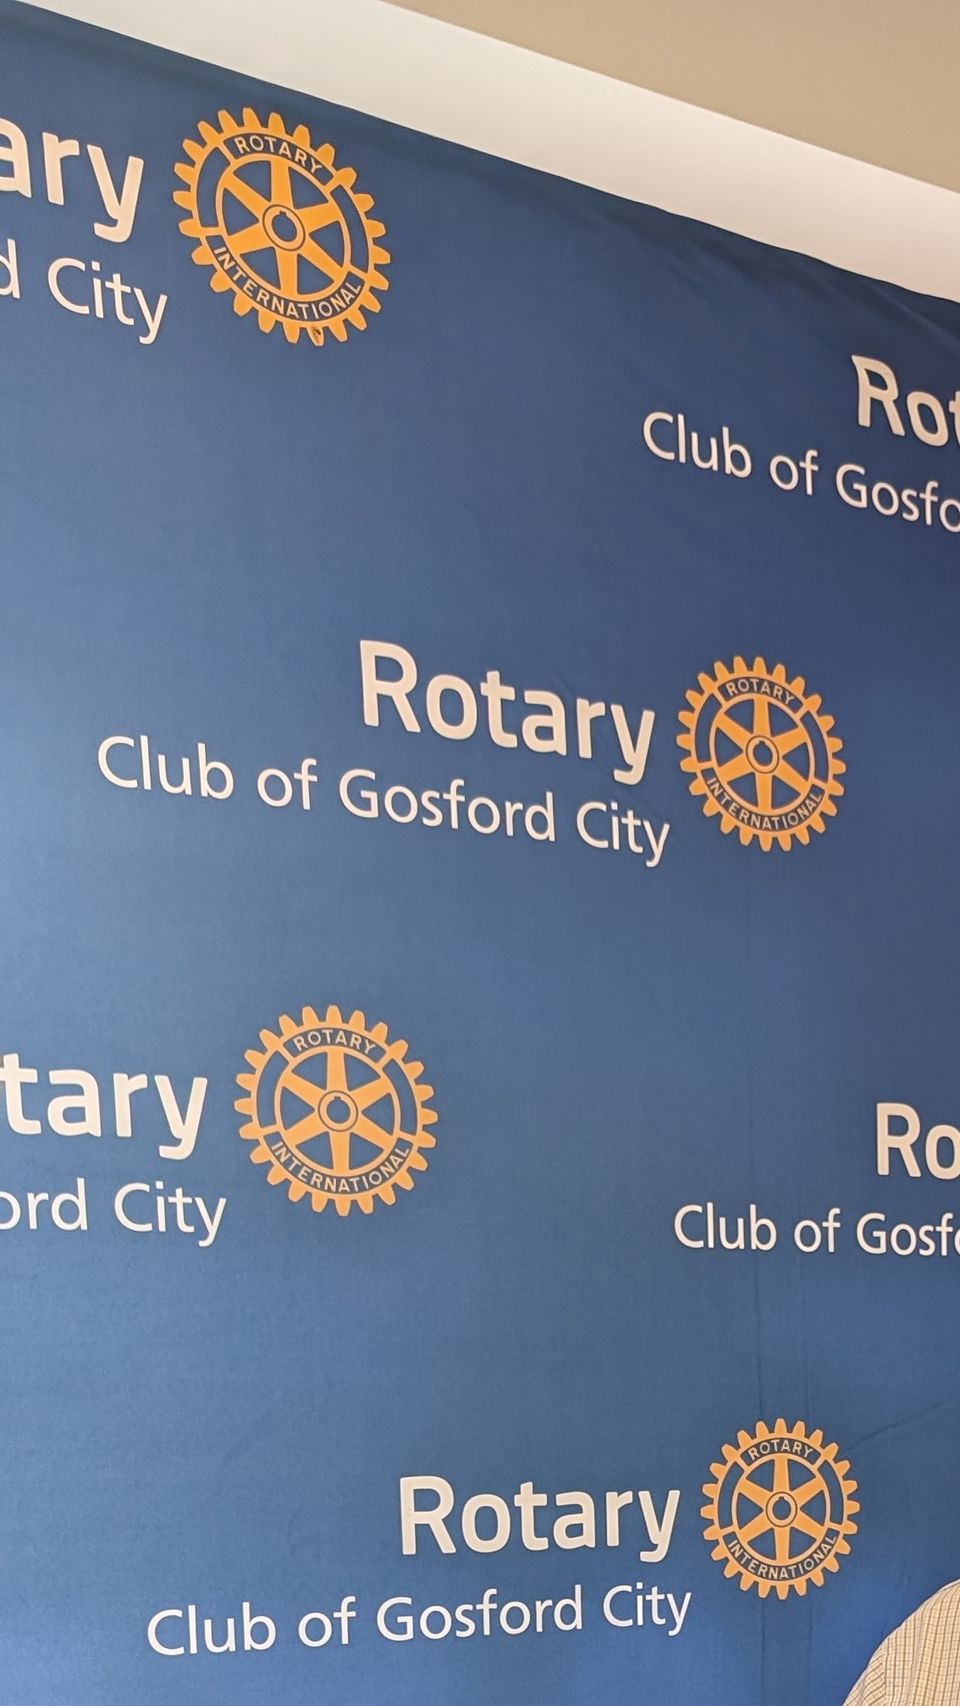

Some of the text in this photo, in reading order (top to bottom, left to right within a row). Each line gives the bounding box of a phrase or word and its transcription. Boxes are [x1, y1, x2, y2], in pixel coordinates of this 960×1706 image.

[0, 117, 145, 243] ary
[235, 136, 323, 174] ROTARY
[47, 256, 168, 345] City
[213, 245, 362, 320] INTERNATIONAL
[643, 411, 752, 478] Club
[769, 449, 819, 496] of
[359, 639, 656, 786] Rotary
[726, 678, 794, 705] ROTARY
[97, 732, 671, 868] Club of Gosford City
[707, 777, 822, 830] INTERNATIONAL
[293, 1029, 376, 1055] ROTARY
[0, 1051, 209, 1161] tary
[272, 1140, 411, 1194] INTERNATIONAL
[112, 1180, 228, 1248] City
[673, 1201, 777, 1251] Club
[793, 1207, 841, 1253] of
[748, 1439, 815, 1461] ROTARY
[399, 1475, 681, 1563] Rotary
[729, 1535, 838, 1581] INTERNATIONAL
[146, 1583, 692, 1657] Club of Gosford City
